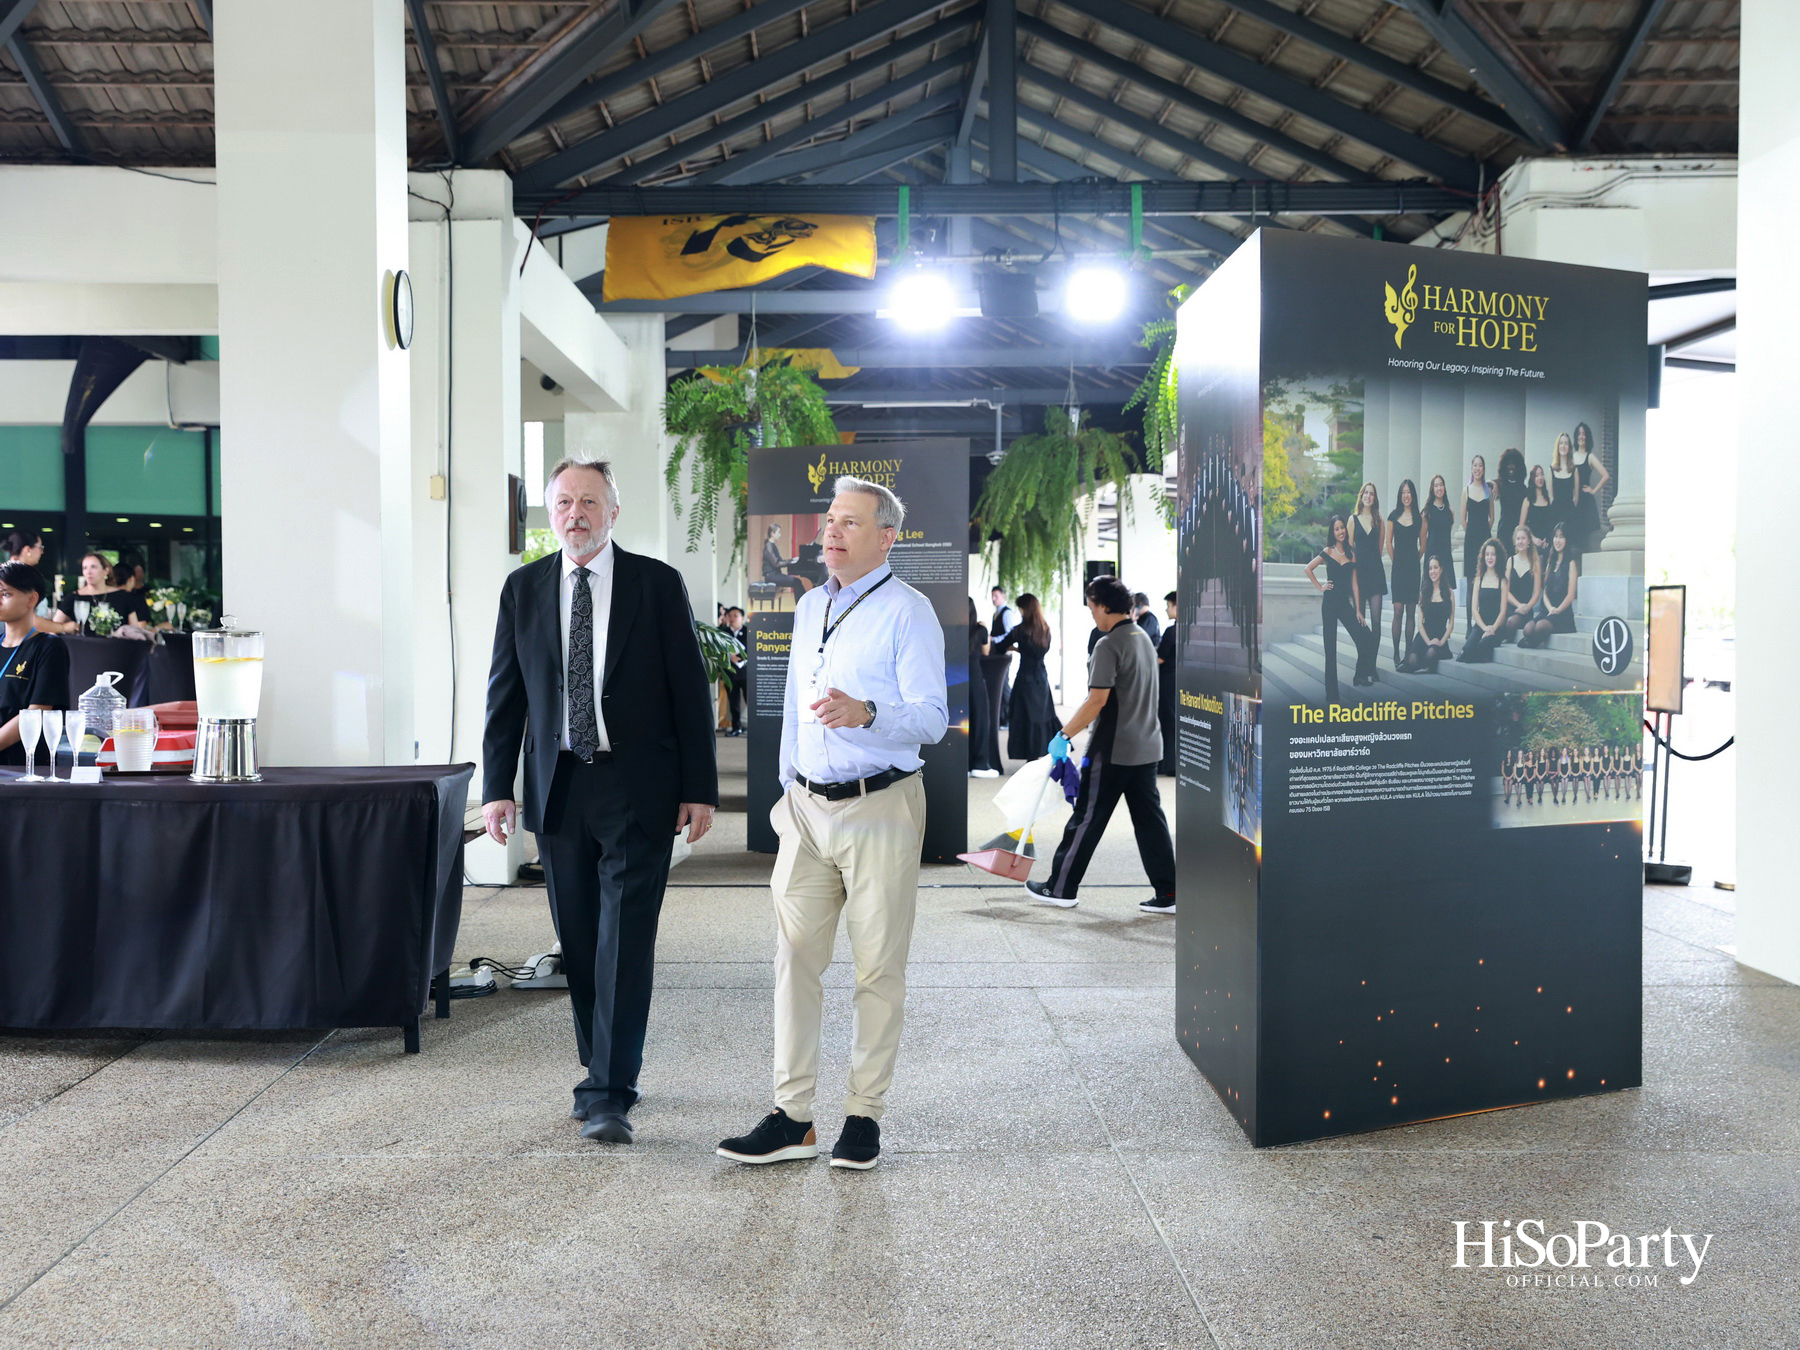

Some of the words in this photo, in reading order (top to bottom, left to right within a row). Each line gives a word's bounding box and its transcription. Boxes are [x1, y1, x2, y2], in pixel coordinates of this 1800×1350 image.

[1422, 284, 1550, 321] HARMONY
[1433, 321, 1456, 335] FOR
[1456, 316, 1538, 352] HOPE
[1388, 357, 1424, 371] Honoring
[1425, 360, 1441, 371] Our
[1441, 361, 1470, 374] Legacy.
[1471, 364, 1504, 378] Inspiring
[1505, 366, 1519, 377] The
[1519, 368, 1546, 379] Future.
[828, 459, 903, 475] HARMONY
[906, 529, 924, 539] Lee
[1289, 704, 1325, 724] The
[1329, 701, 1407, 723] Radcliffe
[1411, 700, 1475, 720] Pitches
